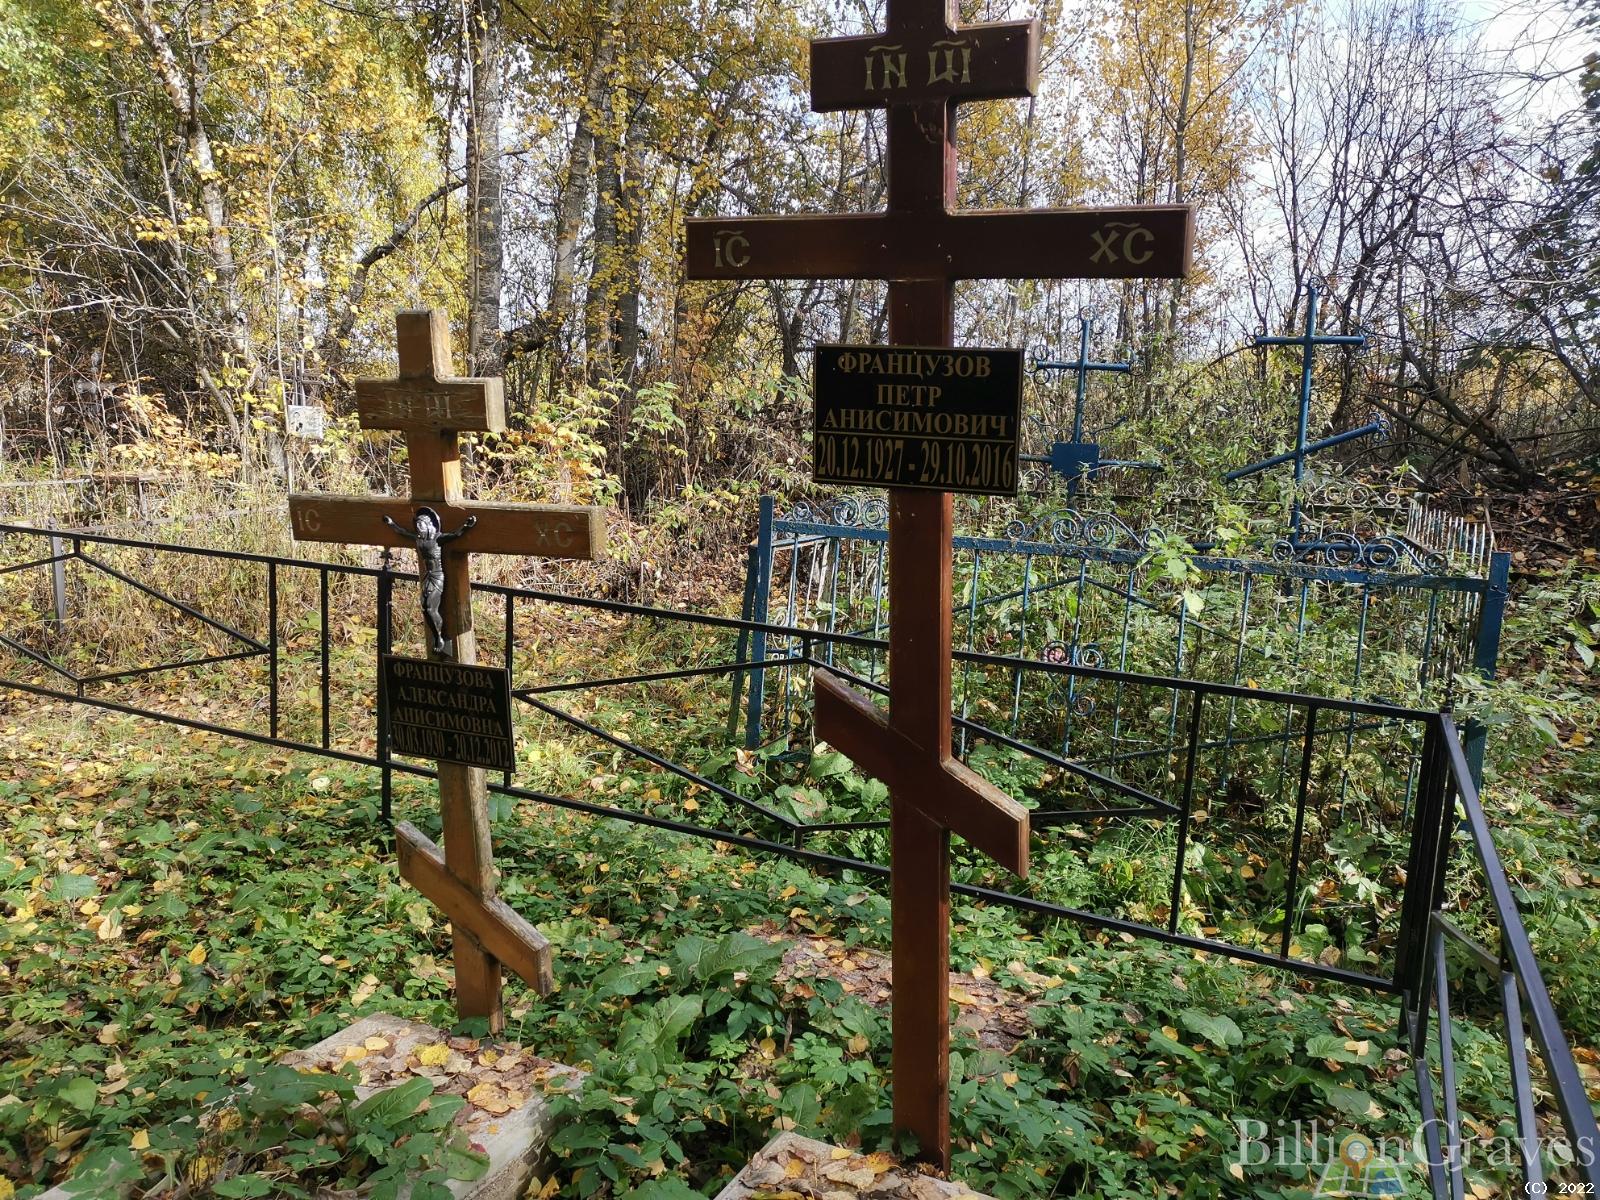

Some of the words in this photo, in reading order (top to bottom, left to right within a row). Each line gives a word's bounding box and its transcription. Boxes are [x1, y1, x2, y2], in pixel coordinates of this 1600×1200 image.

[837, 351, 991, 379] ФРАНЦУЗОВ
[876, 384, 942, 407] ПЕТР
[823, 408, 1006, 437] АНИСИМОВИЧ
[818, 435, 904, 481] 20.12.1927
[919, 440, 1014, 489] 29.10.2016
[393, 662, 495, 689] ФРАНЦУЗОВА
[398, 686, 496, 714] АЛЕКСАНДРА
[394, 706, 504, 736] АНИСИМОВНА
